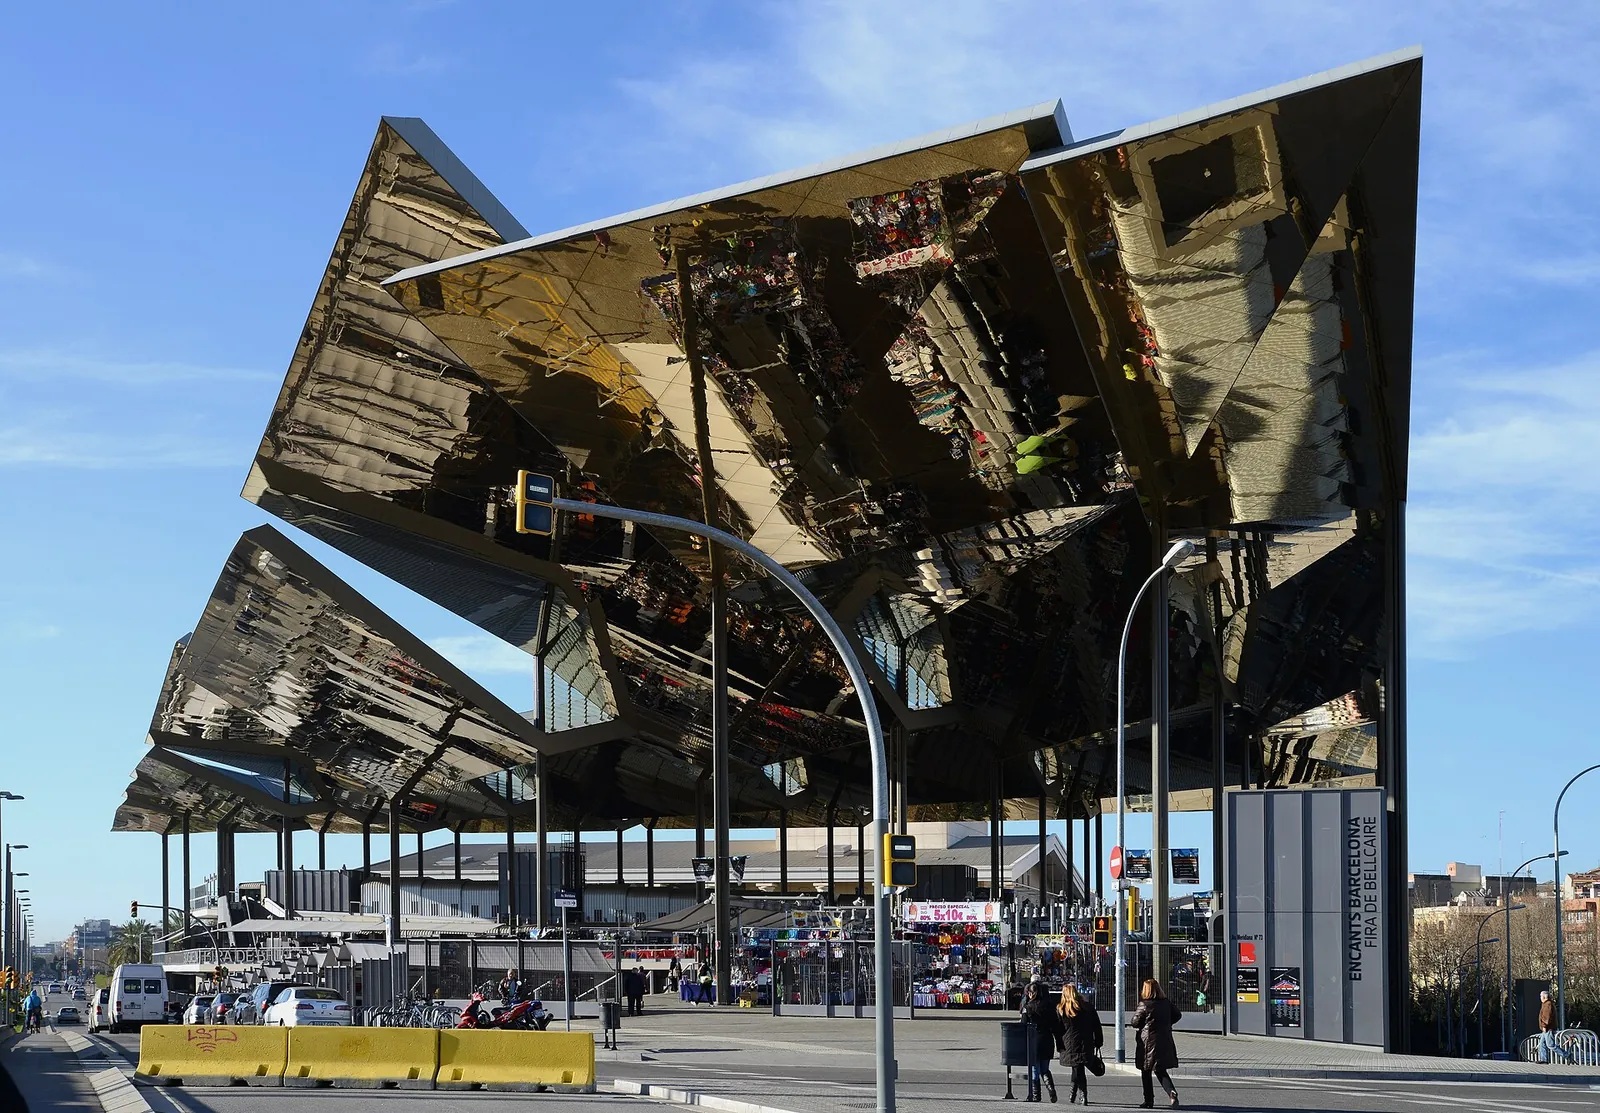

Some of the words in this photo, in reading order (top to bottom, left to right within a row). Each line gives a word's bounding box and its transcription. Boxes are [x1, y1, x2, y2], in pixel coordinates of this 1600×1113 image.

[1348, 816, 1361, 908] BARCELONA
[1363, 816, 1377, 890] BELLCAIRE
[1364, 894, 1377, 912] DE
[1348, 912, 1362, 981] ENCANTS
[1364, 916, 1377, 948] FIRA
[187, 1028, 238, 1041] LSD
